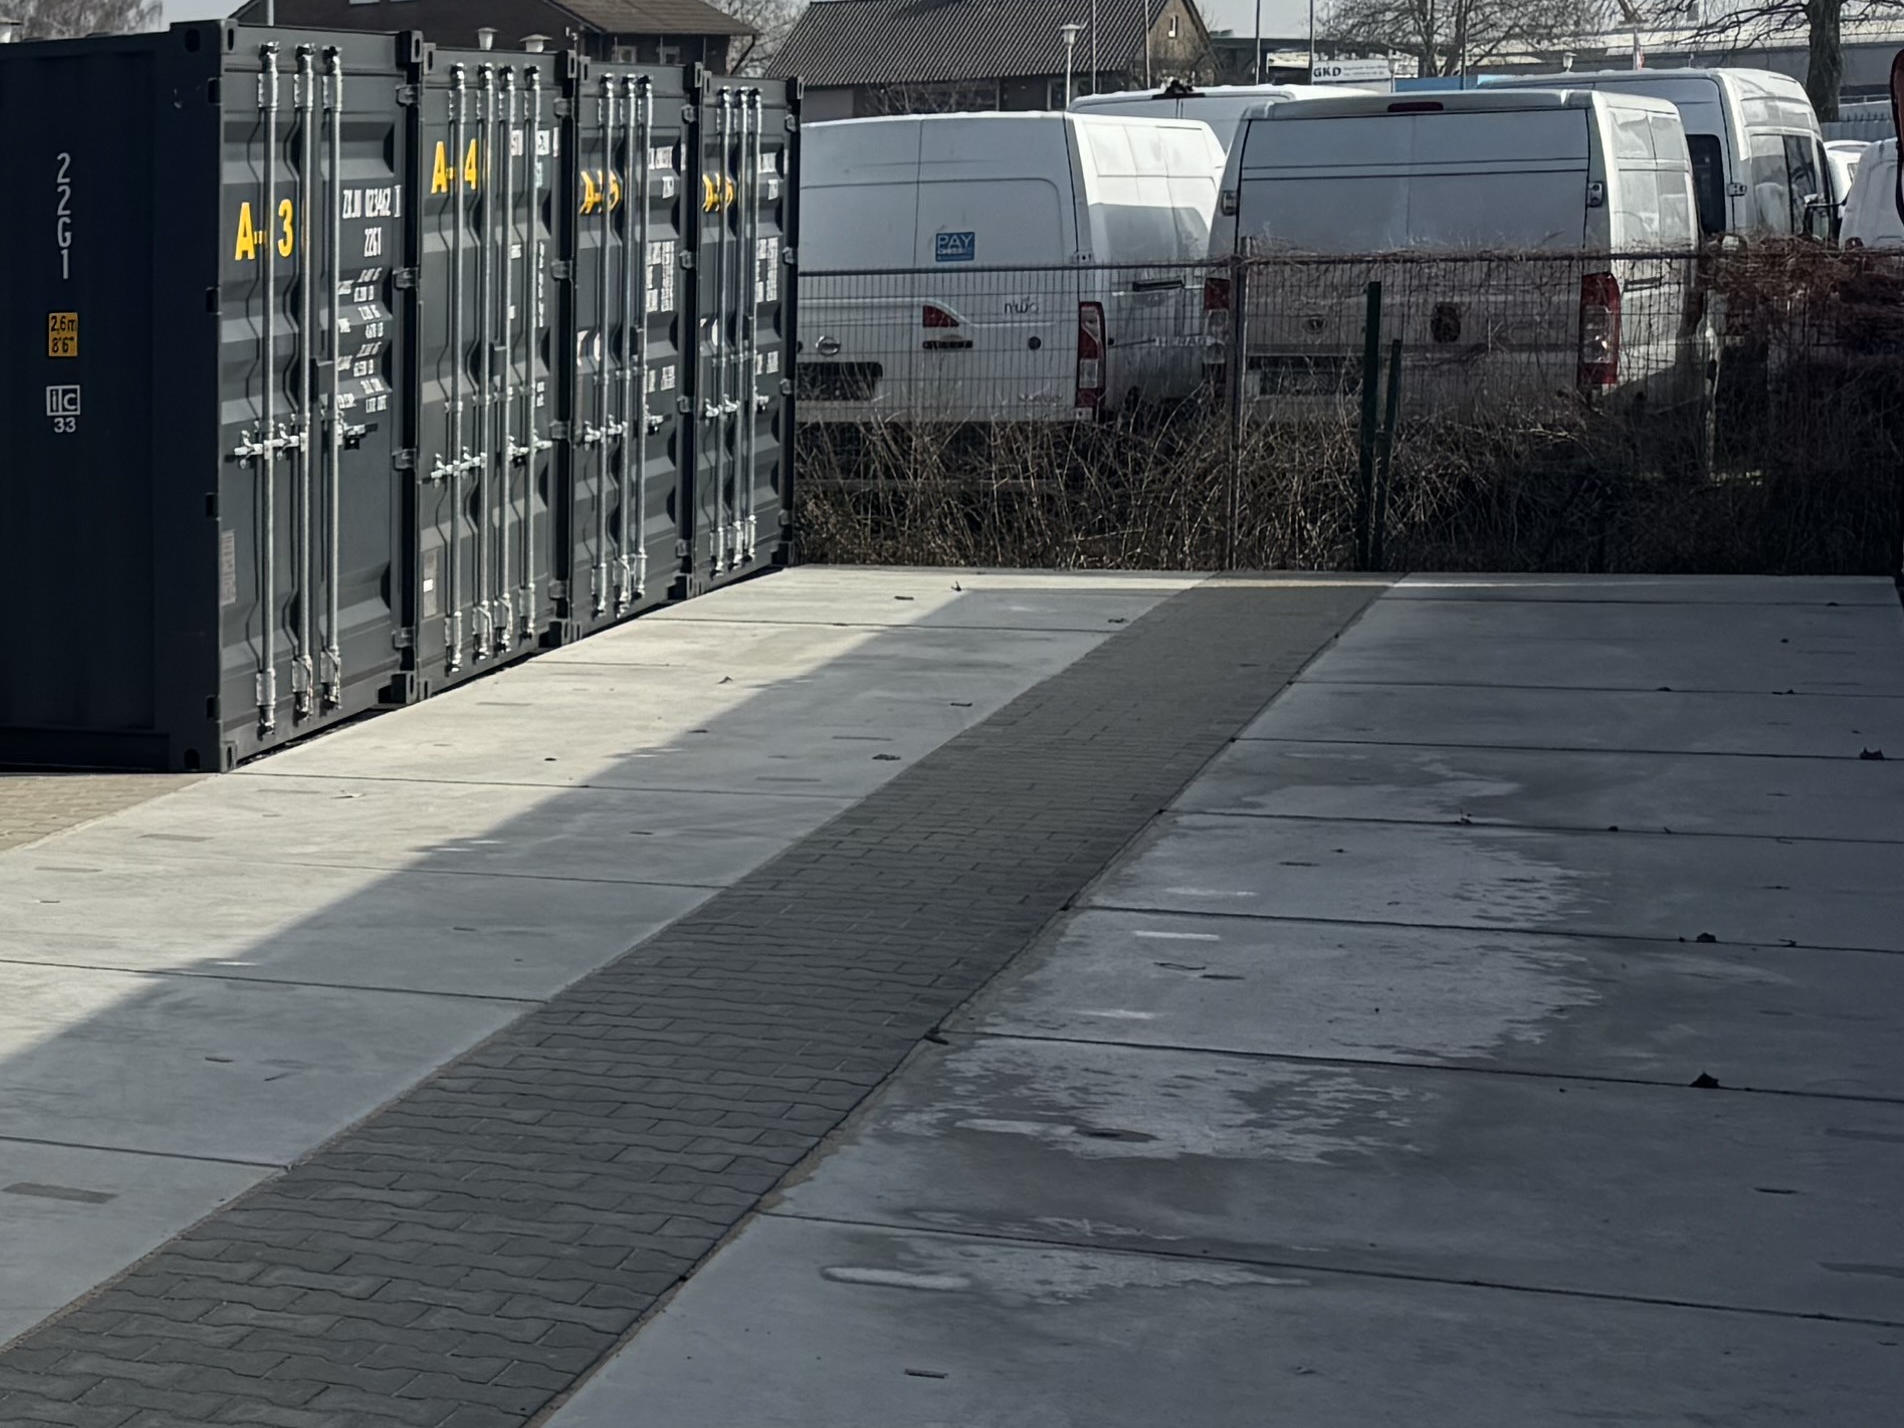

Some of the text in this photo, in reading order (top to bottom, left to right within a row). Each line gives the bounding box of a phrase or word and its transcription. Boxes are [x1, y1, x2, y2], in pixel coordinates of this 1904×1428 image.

[1313, 67, 1341, 78] GKD
[431, 137, 479, 194] A-4
[56, 152, 72, 280] 22G1
[234, 198, 293, 260] A-3
[937, 234, 973, 250] PAY
[53, 417, 77, 433] 33
